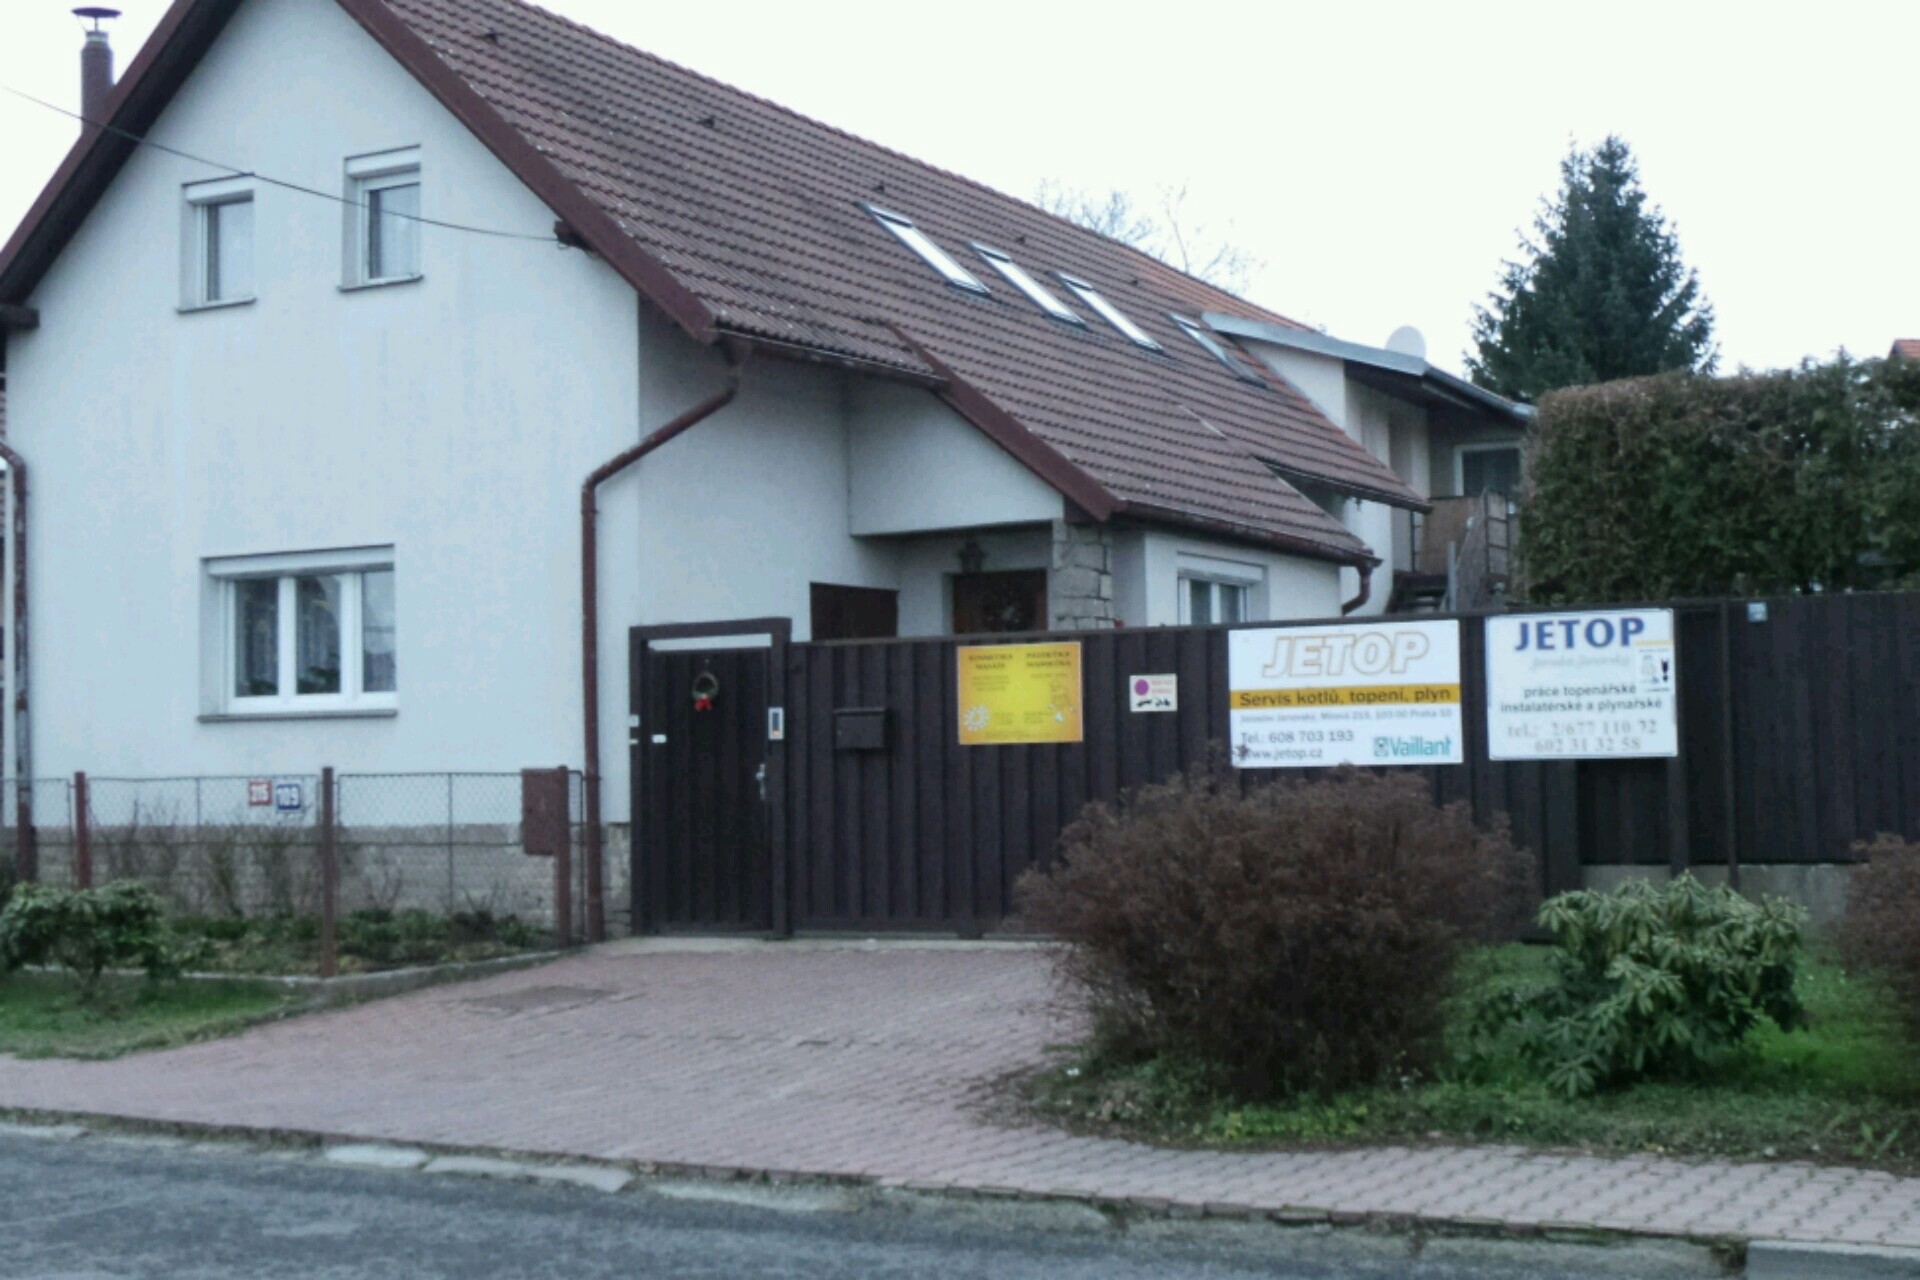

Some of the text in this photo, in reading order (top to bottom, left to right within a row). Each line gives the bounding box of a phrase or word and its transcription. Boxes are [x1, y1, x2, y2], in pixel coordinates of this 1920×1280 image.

[1515, 617, 1645, 651] JETOP
[1262, 631, 1429, 678] JETOP
[1240, 685, 1450, 706] Servis kotlů, topení, plyn
[1524, 684, 1559, 698] práce
[1586, 702, 1593, 710] a
[1269, 731, 1295, 743] 608
[1300, 730, 1324, 742] 703
[1329, 730, 1354, 742] 193
[1390, 735, 1451, 756] Vaillant
